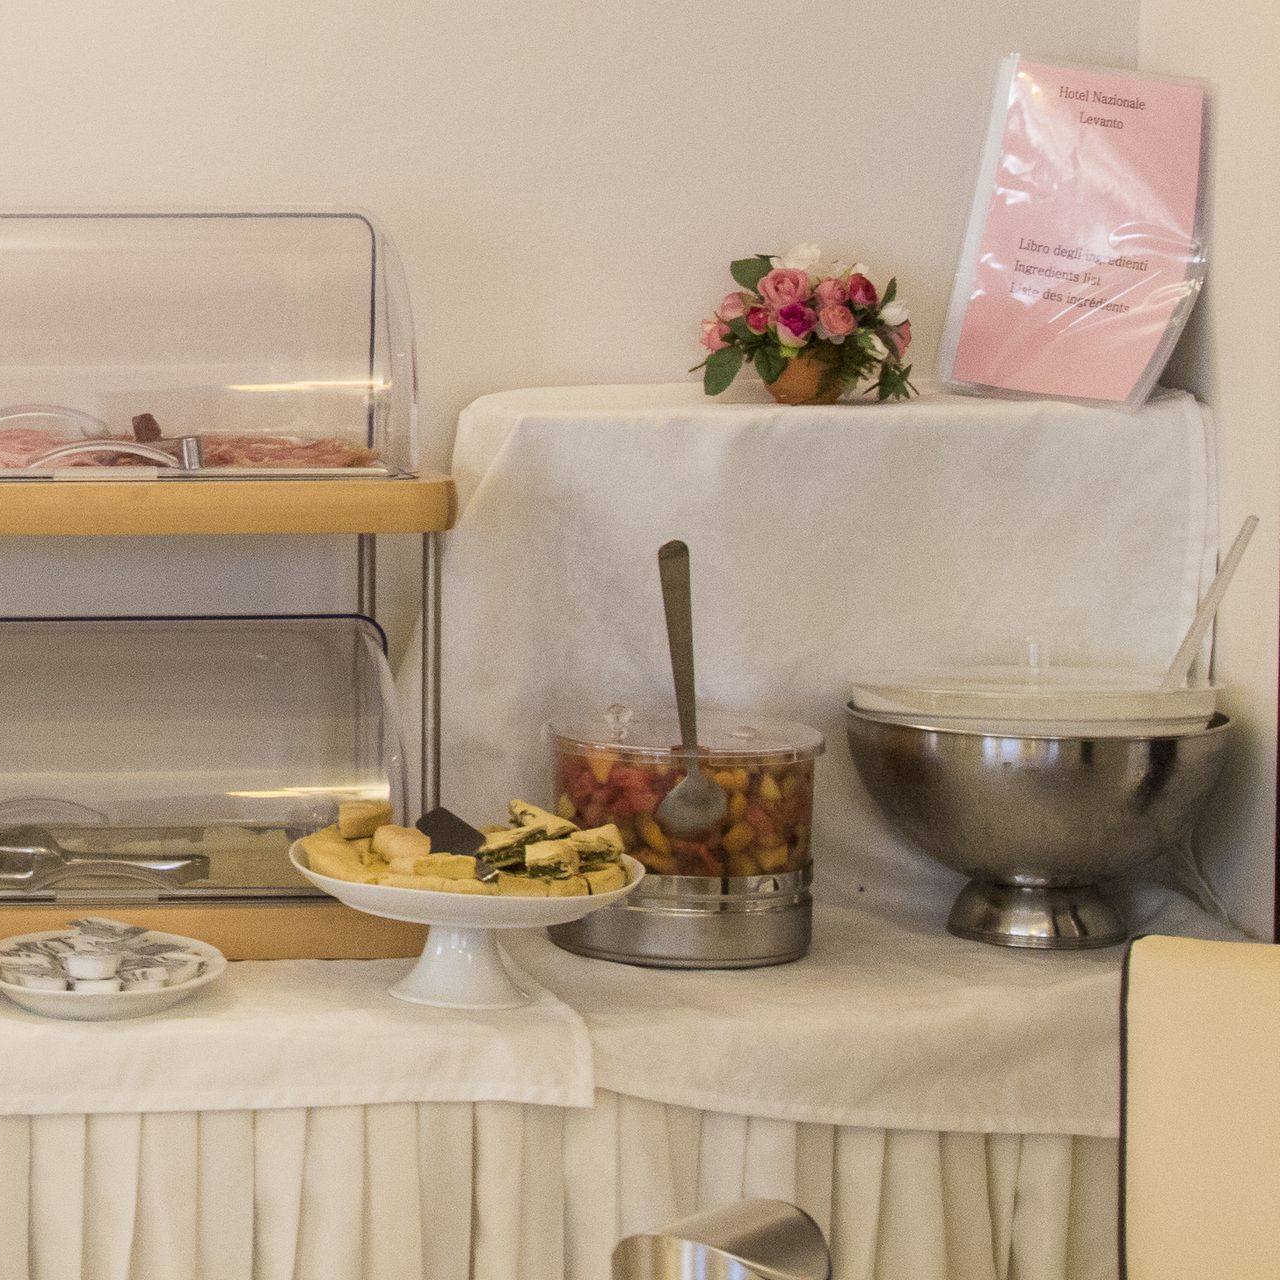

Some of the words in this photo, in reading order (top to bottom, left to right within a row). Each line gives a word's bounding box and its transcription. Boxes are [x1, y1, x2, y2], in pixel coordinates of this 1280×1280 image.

[1059, 86, 1089, 102] Hotel
[1092, 91, 1146, 110] Nazionale
[1080, 112, 1124, 130] Levanto
[1018, 237, 1049, 254] Libro
[1053, 244, 1083, 261] degli
[1085, 249, 1149, 272] ingedienti
[1014, 260, 1080, 283] Ingredients
[1083, 272, 1101, 287] list
[1042, 288, 1063, 303] des
